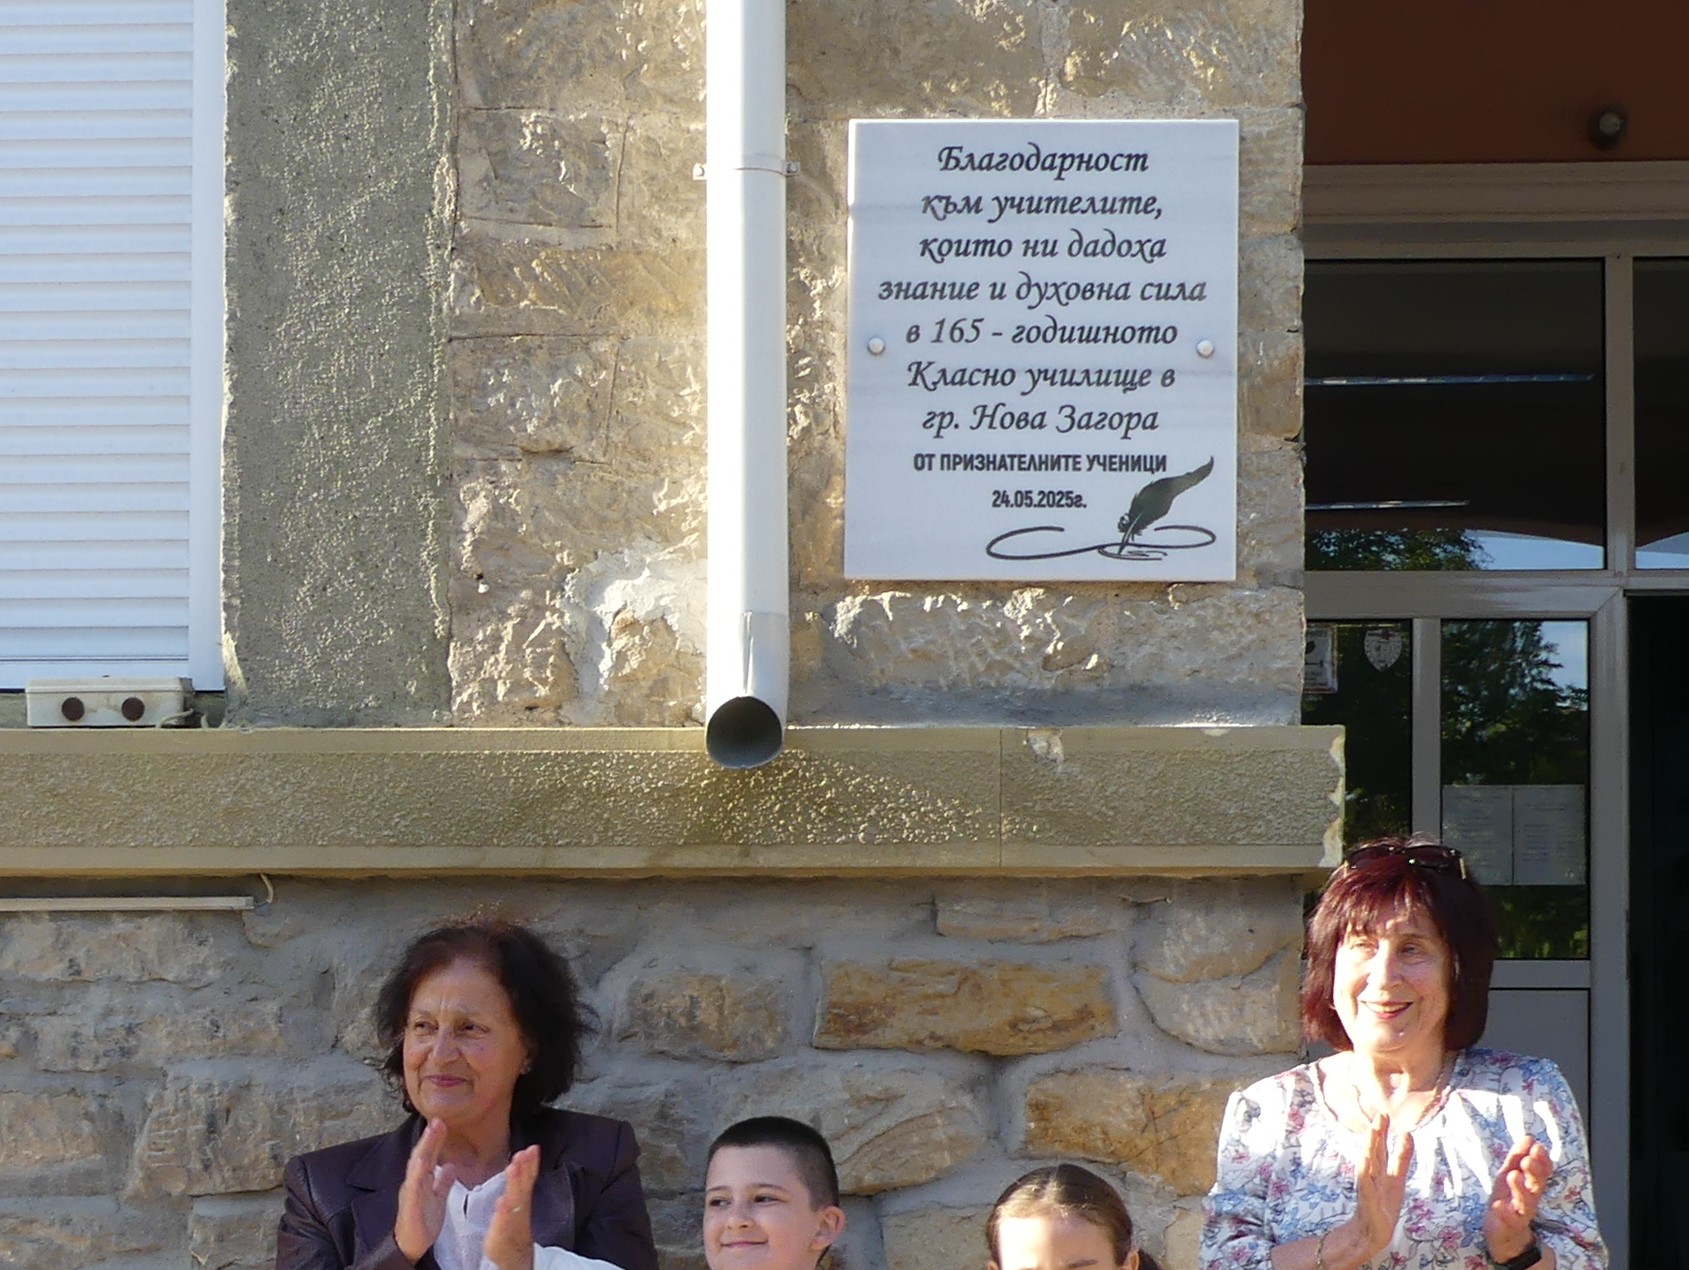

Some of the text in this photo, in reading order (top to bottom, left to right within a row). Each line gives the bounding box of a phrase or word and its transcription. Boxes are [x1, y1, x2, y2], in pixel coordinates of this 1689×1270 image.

[938, 142, 1148, 181] Благодарност
[922, 194, 1163, 223] към учителите,
[919, 228, 1167, 264] които ни дадоха
[878, 271, 1207, 310] знание и духовна сила
[906, 324, 921, 343] в
[931, 317, 985, 344] 165
[1011, 315, 1177, 344] годишното
[907, 360, 1176, 396] Класно училище в
[922, 402, 1159, 440] гр. Нова Загора
[913, 453, 1167, 474] ОТ ПРИЗНАТЕЛНИТЕ УЧЕНИЦИ
[991, 490, 1087, 509] 24.05.2025г.
